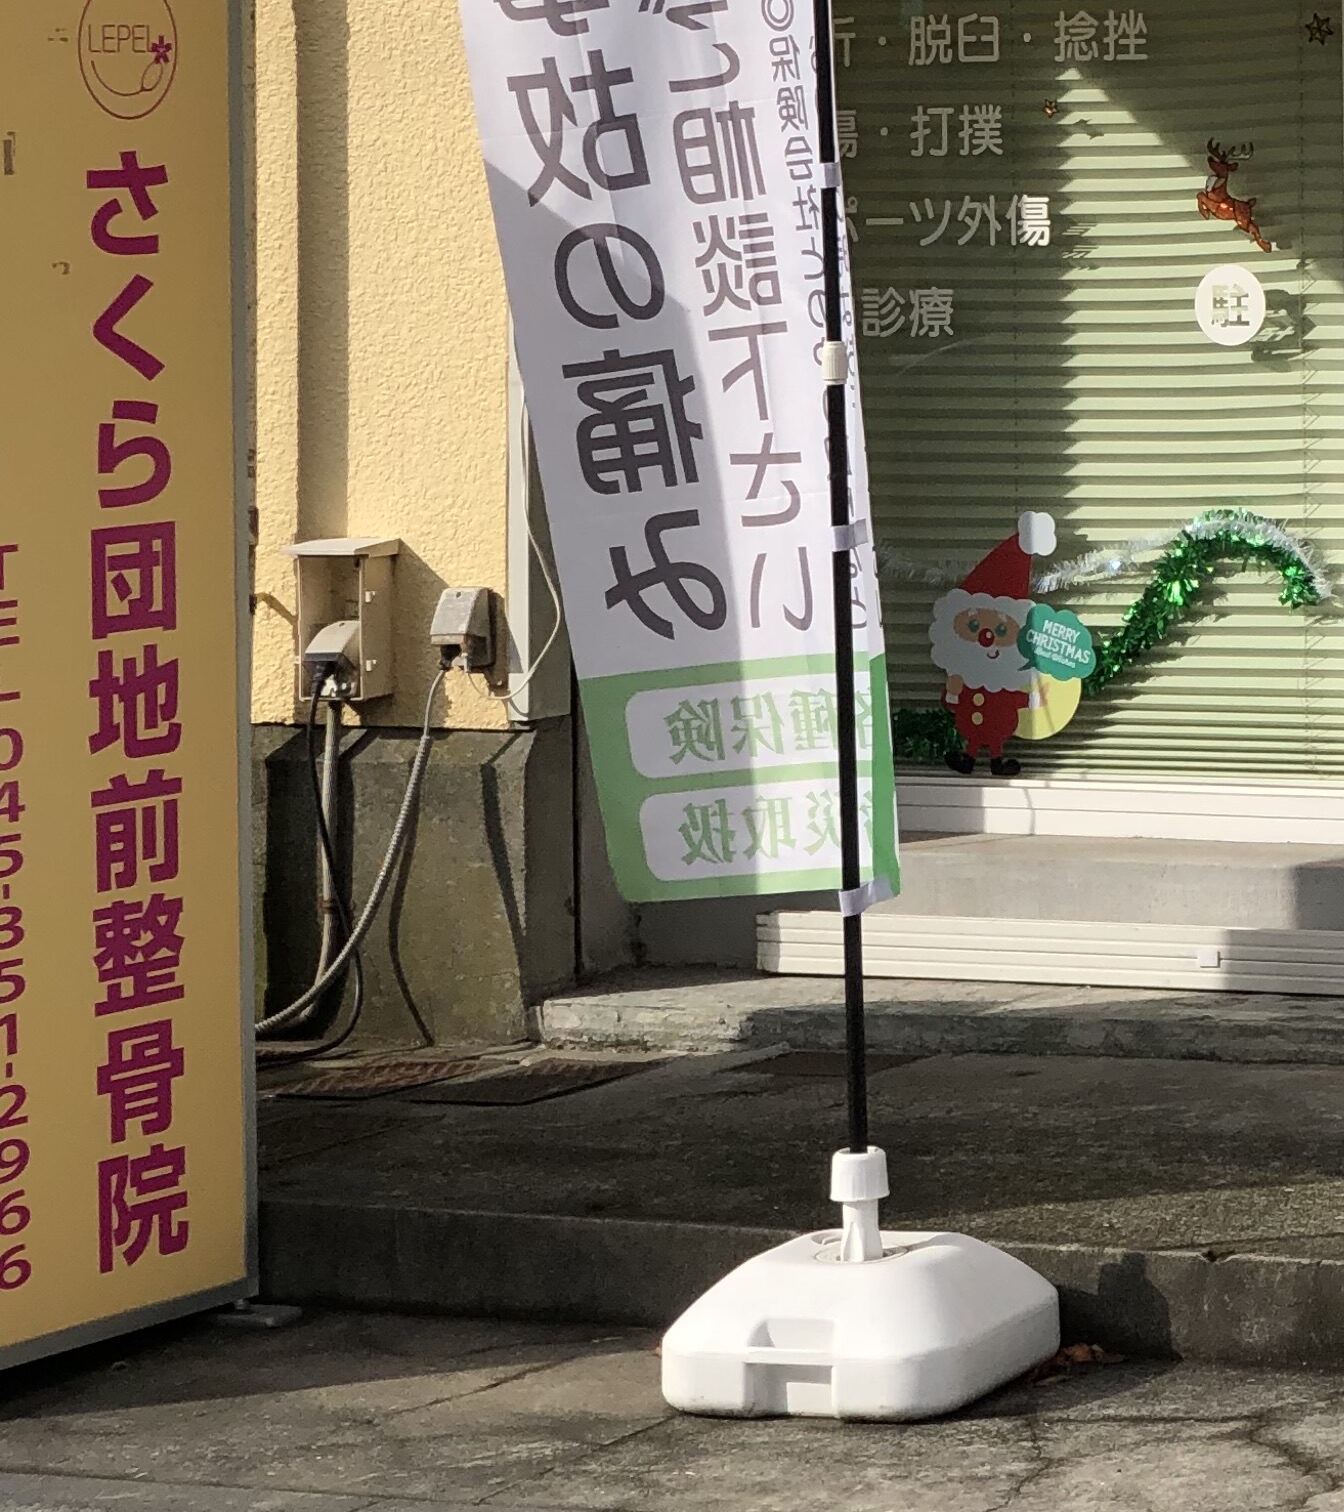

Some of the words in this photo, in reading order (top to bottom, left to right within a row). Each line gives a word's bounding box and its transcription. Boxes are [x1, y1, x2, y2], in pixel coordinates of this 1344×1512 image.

[861, 286, 955, 340] 診療
[1026, 630, 1091, 664] CHRISTMAS
[1042, 619, 1081, 644] MERRY
[86, 150, 190, 1276] さくら団地前整骨院
